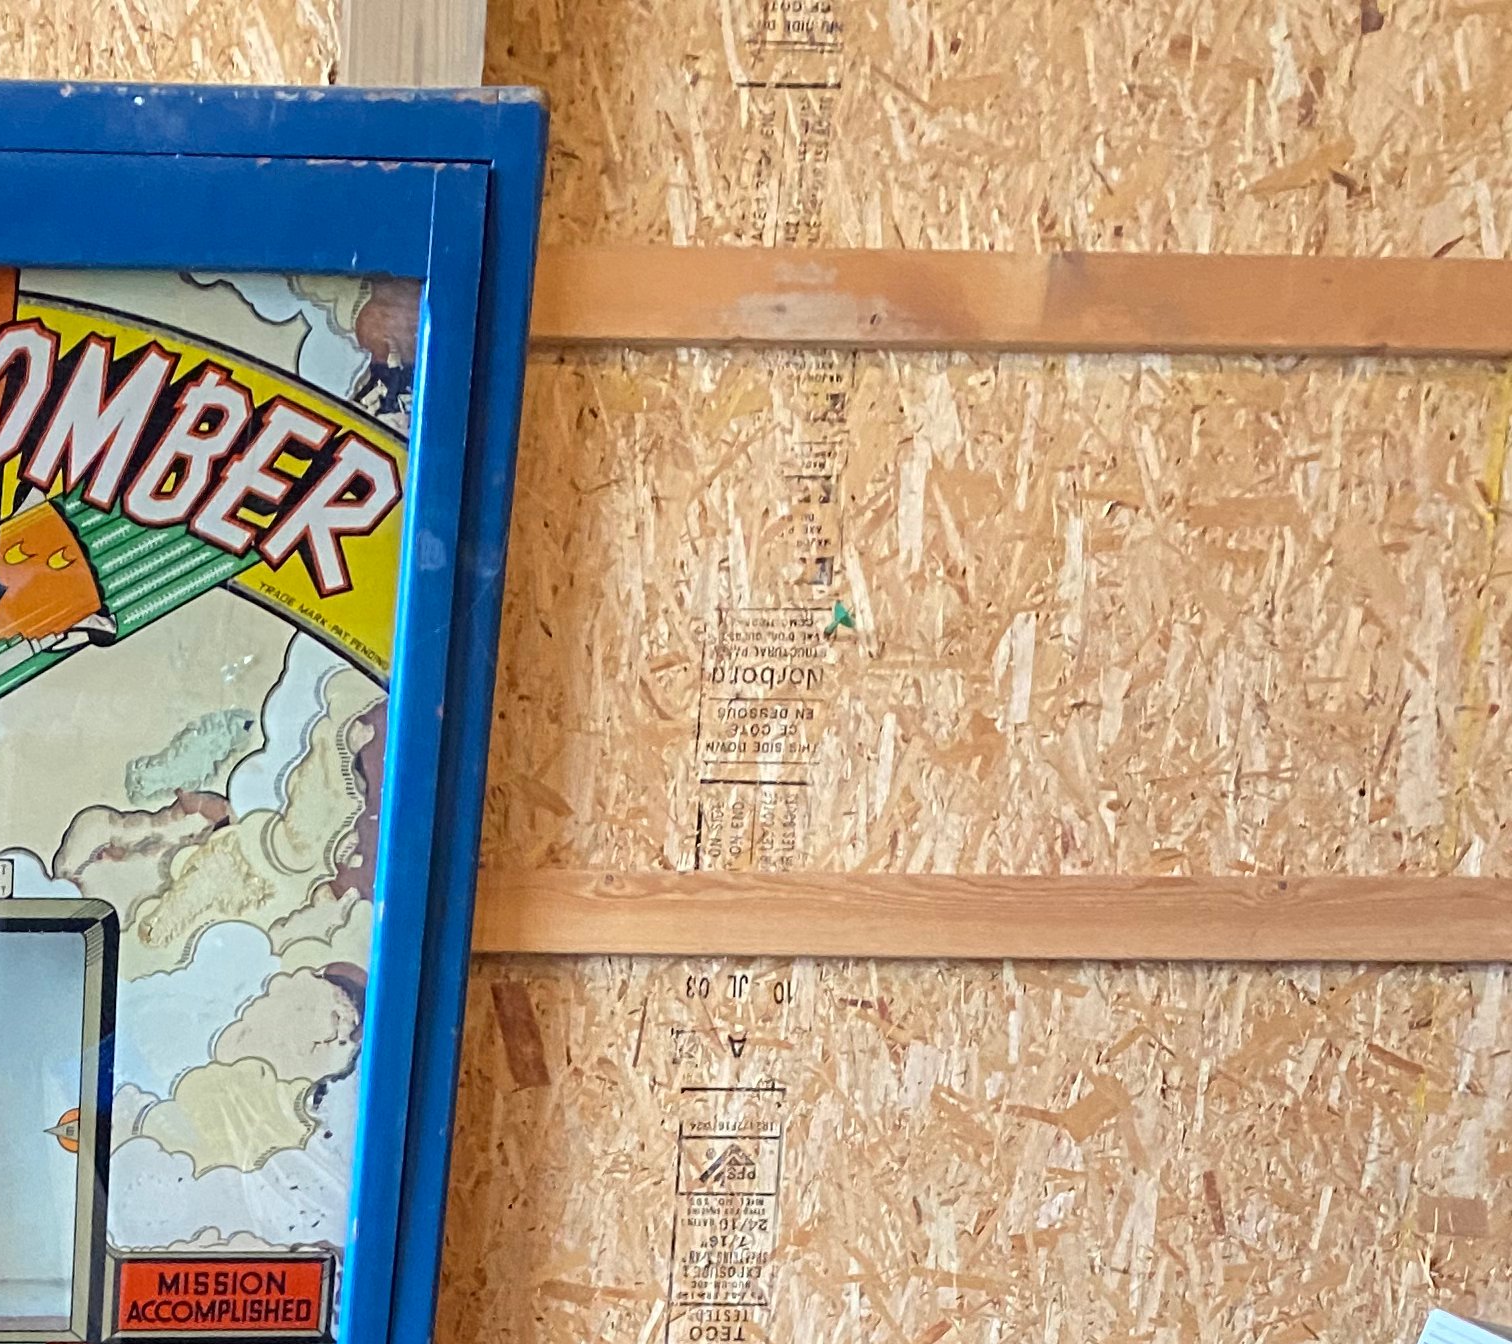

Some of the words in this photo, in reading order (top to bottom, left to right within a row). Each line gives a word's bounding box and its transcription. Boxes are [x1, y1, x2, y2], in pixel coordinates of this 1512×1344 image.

[260, 580, 296, 606] TRADE
[727, 1032, 747, 1059] A
[157, 1270, 287, 1297] MISSION
[126, 1298, 312, 1324] ACCOMPLISHED
[688, 1325, 746, 1343] TECO
